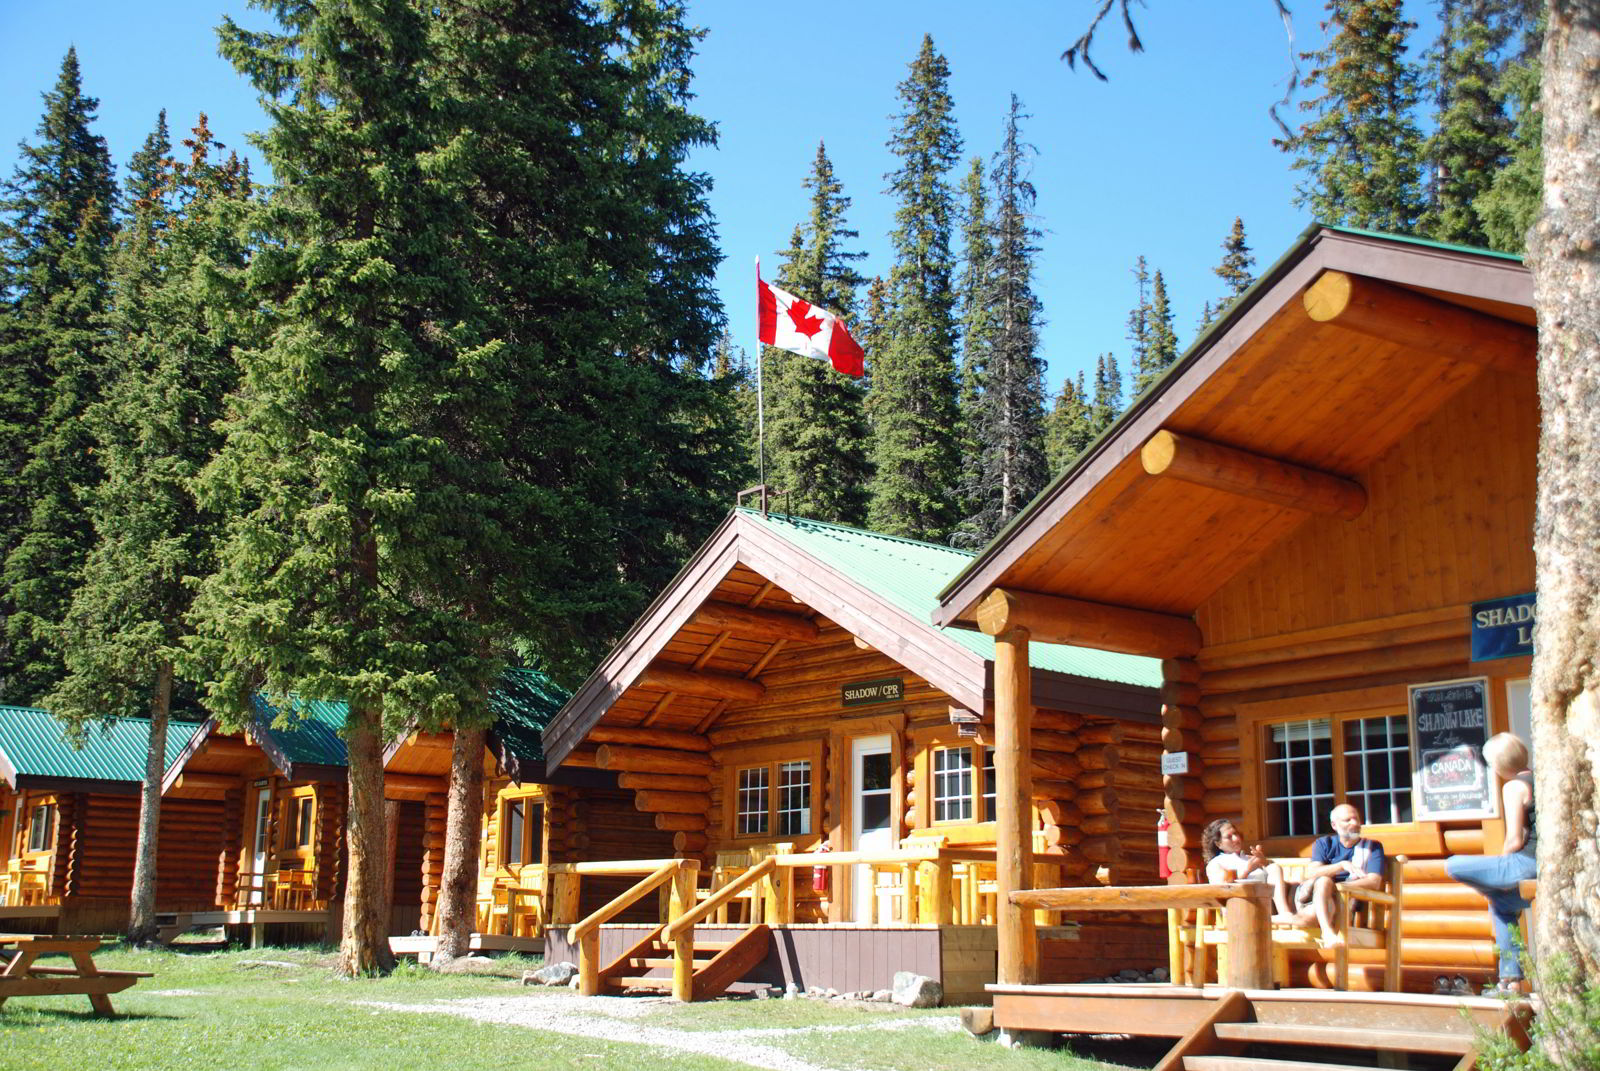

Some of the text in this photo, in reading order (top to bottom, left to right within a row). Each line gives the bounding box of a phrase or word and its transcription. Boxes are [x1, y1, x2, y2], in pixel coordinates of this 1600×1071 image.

[1418, 708, 1484, 732] SHADOW LAKE
[1164, 763, 1180, 771] CHECK
[1431, 758, 1472, 775] CANADA
